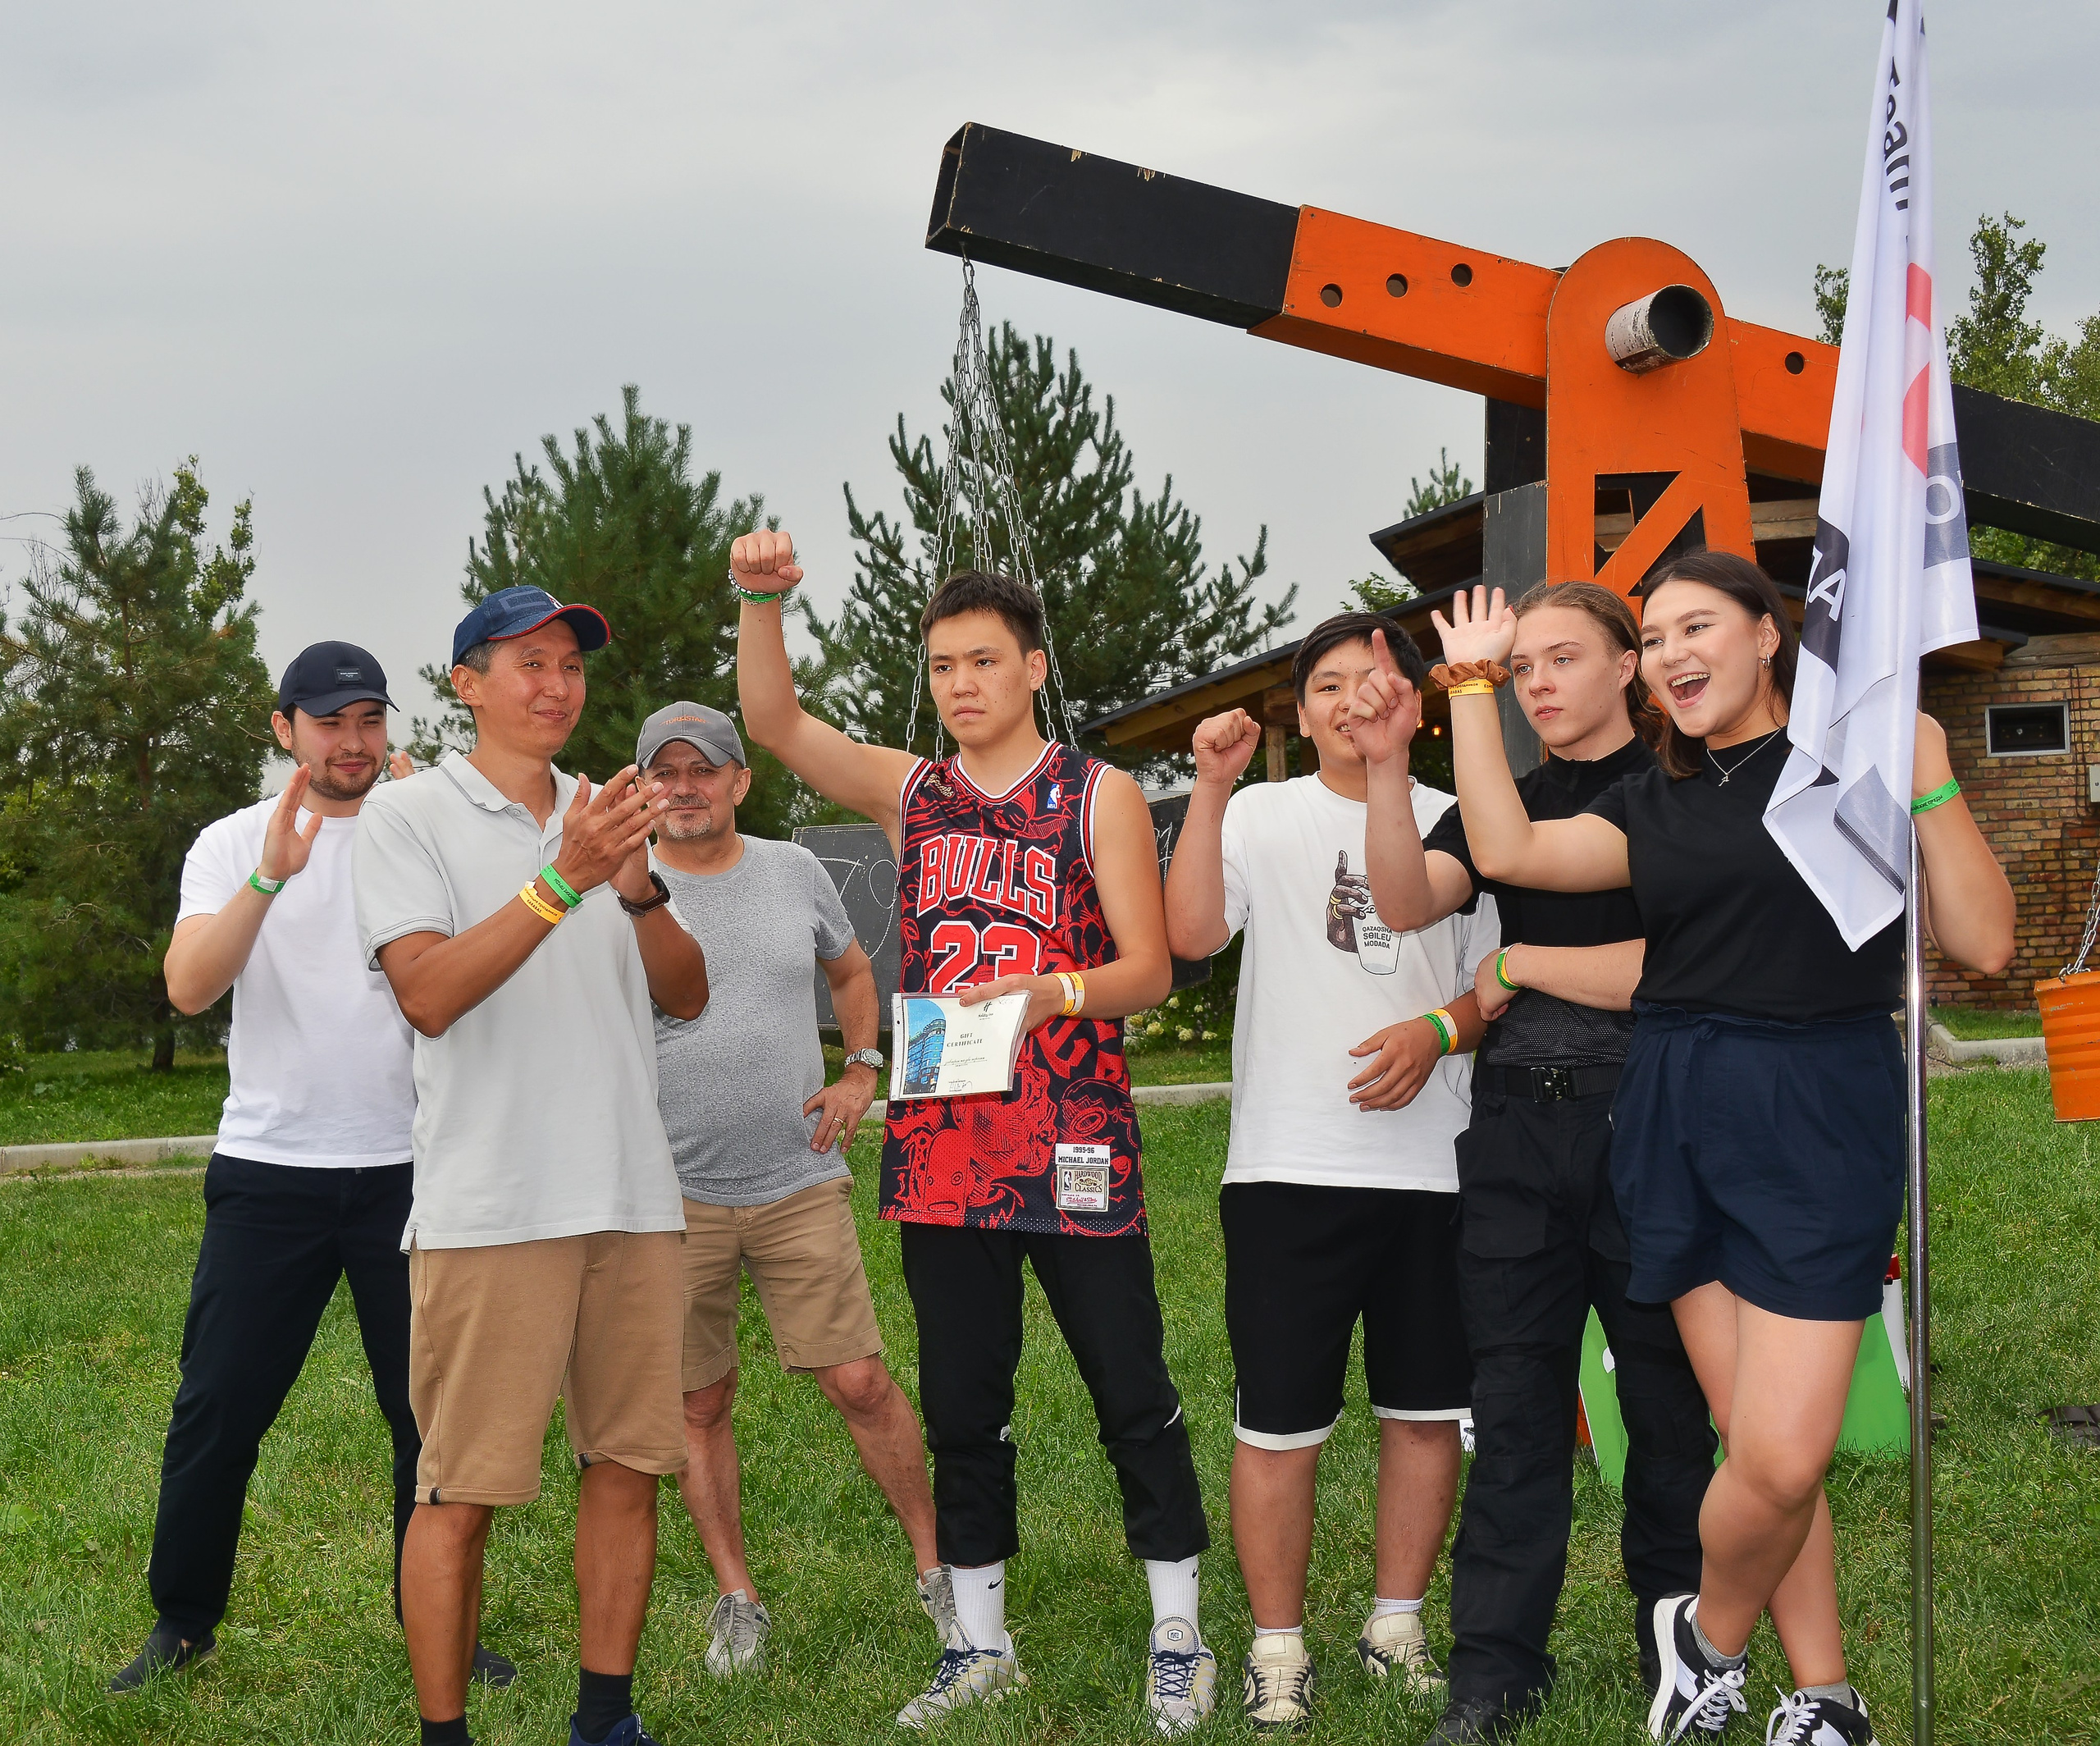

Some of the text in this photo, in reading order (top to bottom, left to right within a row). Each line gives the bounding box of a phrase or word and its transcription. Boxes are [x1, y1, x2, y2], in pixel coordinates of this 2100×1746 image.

[917, 834, 1057, 930] BULLS
[1362, 926, 1393, 935] QAZAQSHA
[1364, 940, 1390, 949] MODADA
[929, 920, 1040, 994] 23
[947, 1039, 984, 1048] CERTIFICATE
[1086, 1157, 1109, 1165] JORDAN
[1074, 1170, 1102, 1182] HARDWOOD
[1075, 1182, 1102, 1193] CLASSICS
